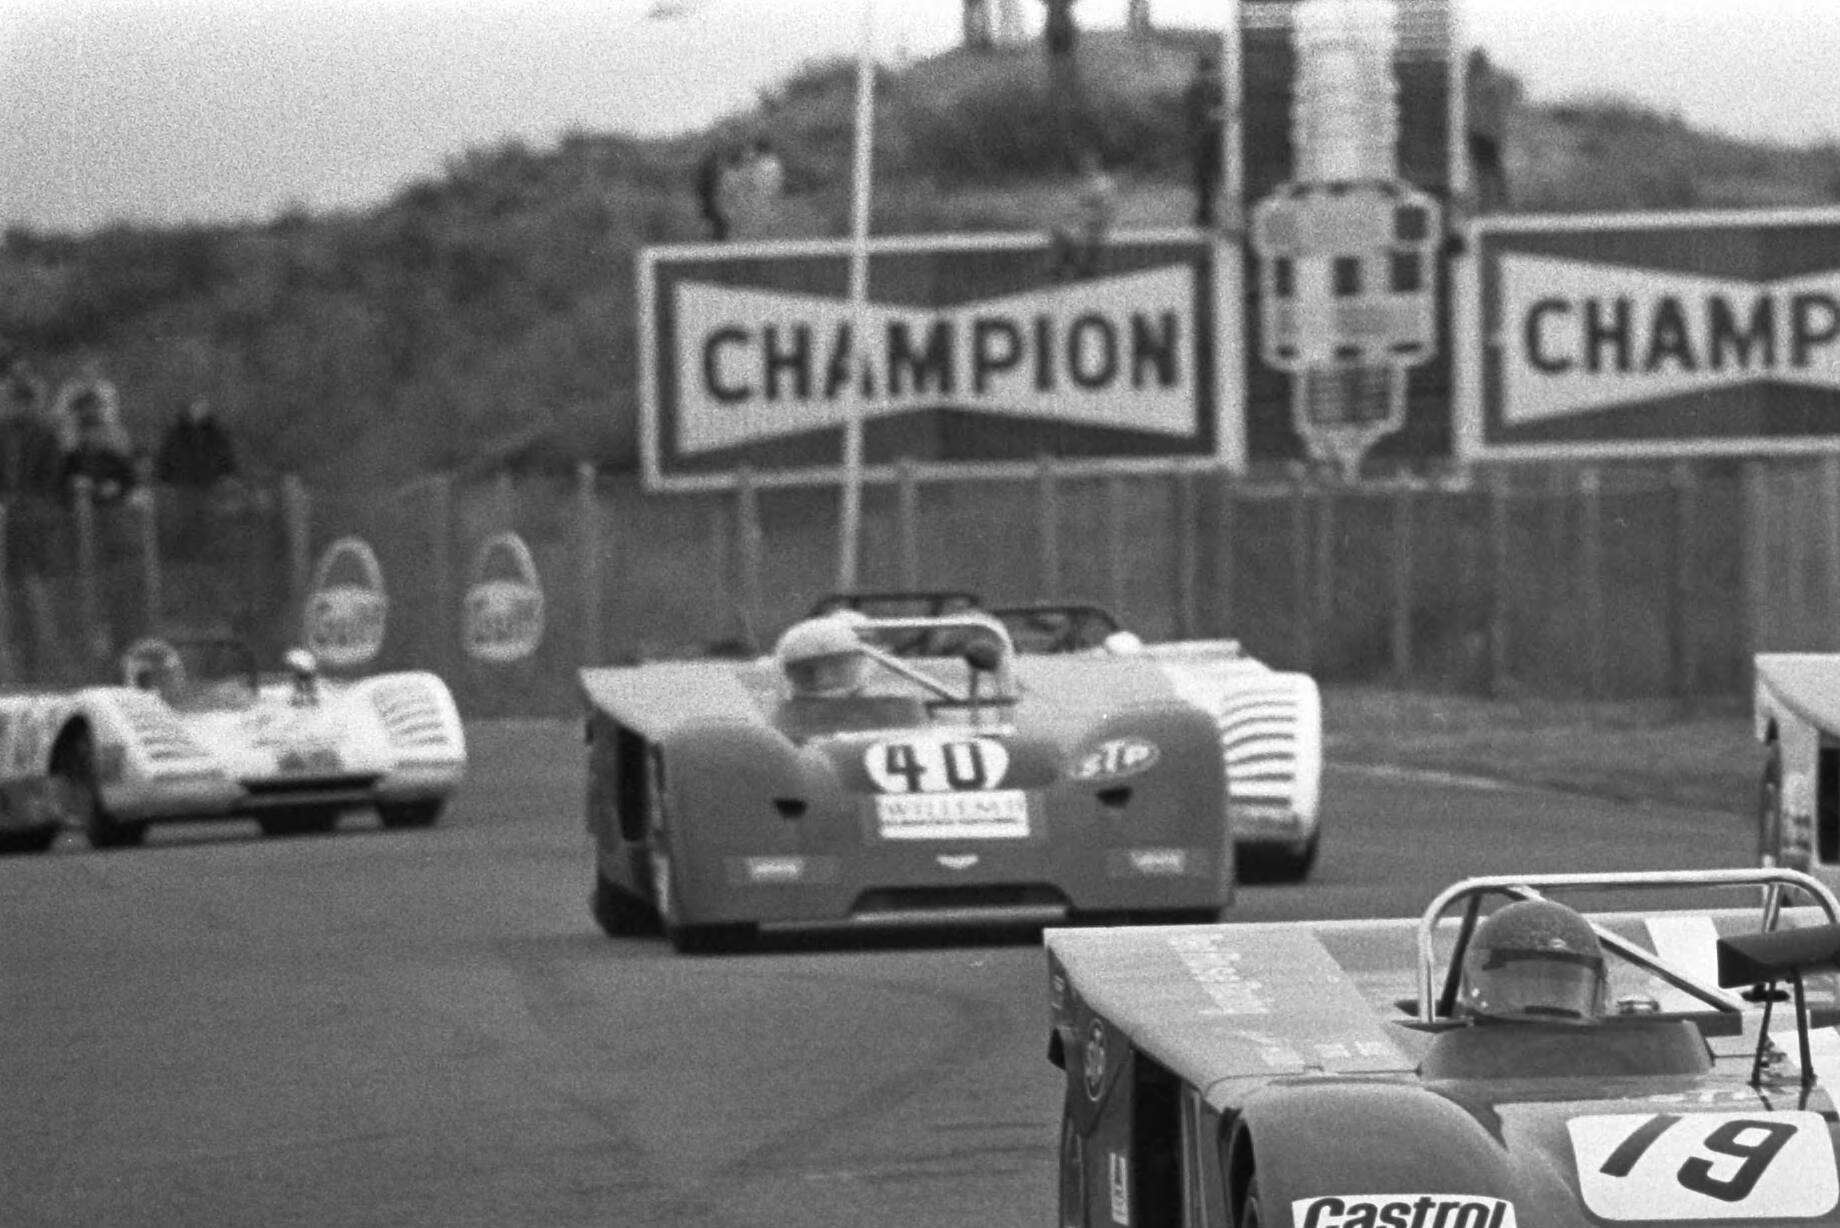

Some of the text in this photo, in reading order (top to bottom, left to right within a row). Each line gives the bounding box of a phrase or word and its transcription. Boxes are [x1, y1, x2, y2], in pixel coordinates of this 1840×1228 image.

[703, 312, 1177, 404] CHAMPION
[885, 742, 987, 792] 40
[1599, 1114, 1799, 1202] 19
